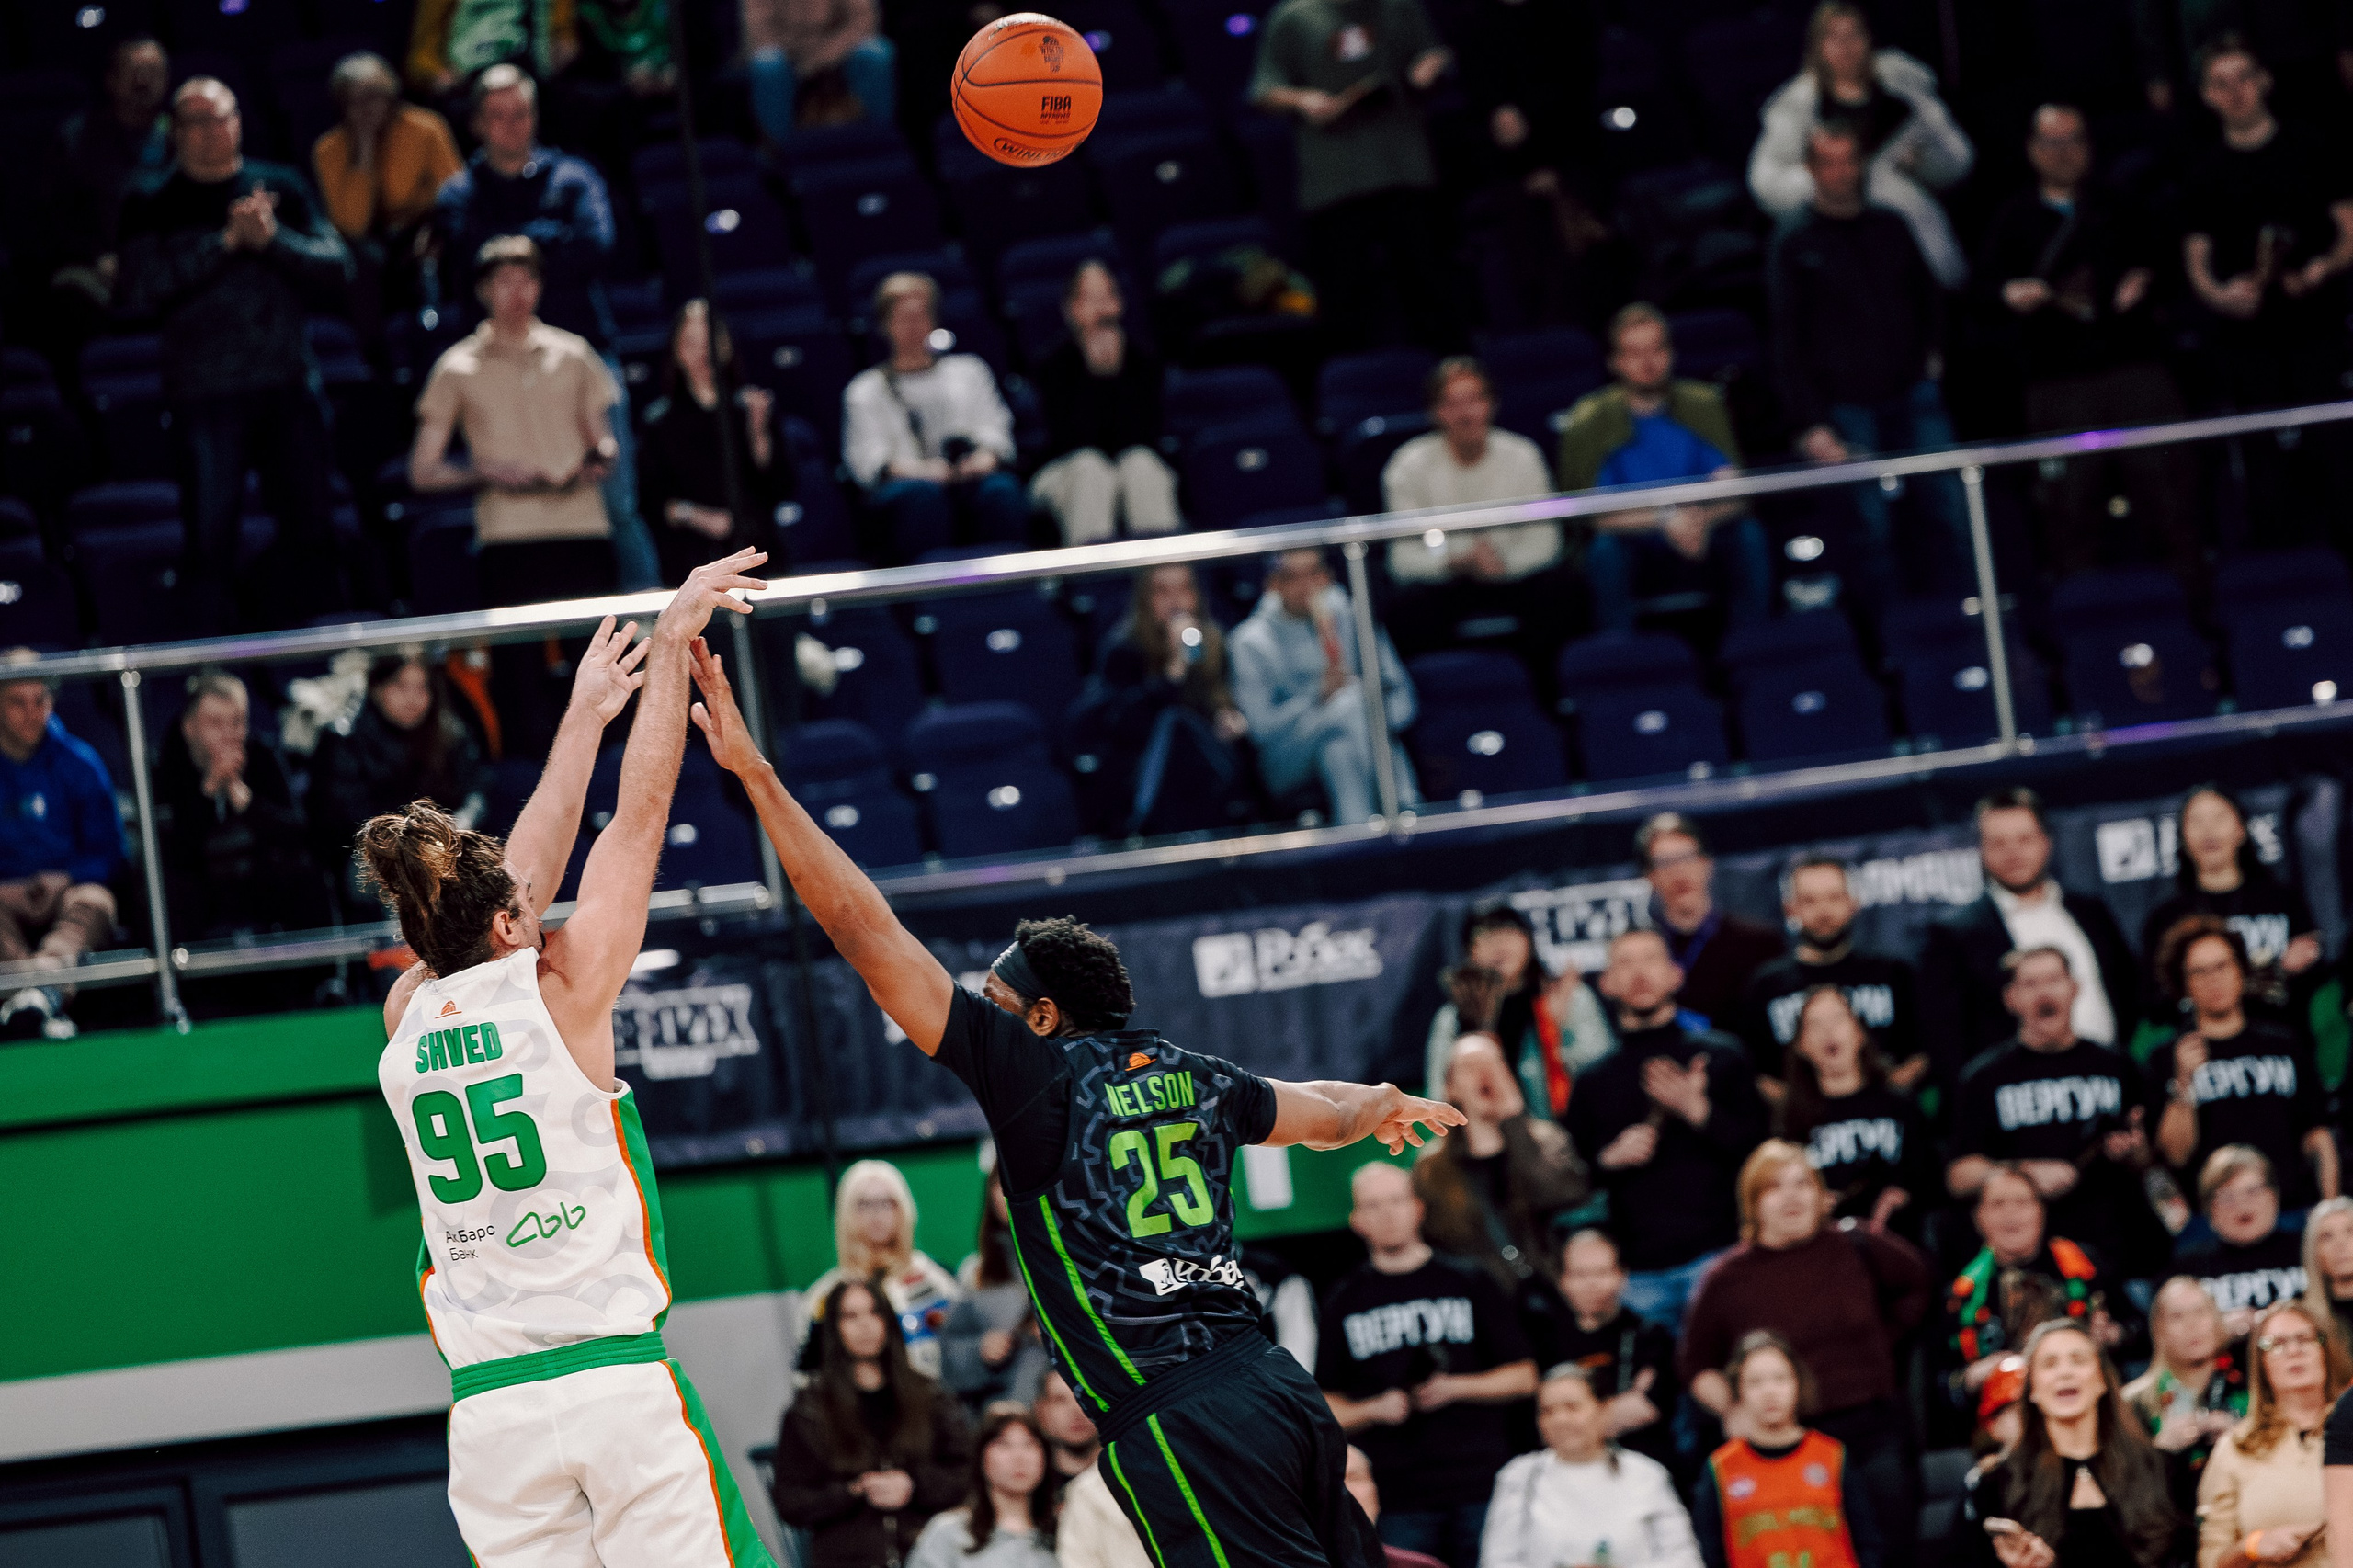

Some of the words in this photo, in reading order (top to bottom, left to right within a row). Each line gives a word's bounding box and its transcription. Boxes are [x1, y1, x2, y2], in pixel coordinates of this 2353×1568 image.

[1041, 96, 1072, 111] FIBA
[415, 1021, 504, 1074] SHVED
[1104, 1071, 1196, 1118] NELSON
[412, 1073, 548, 1205] 95
[1108, 1122, 1215, 1239] 25
